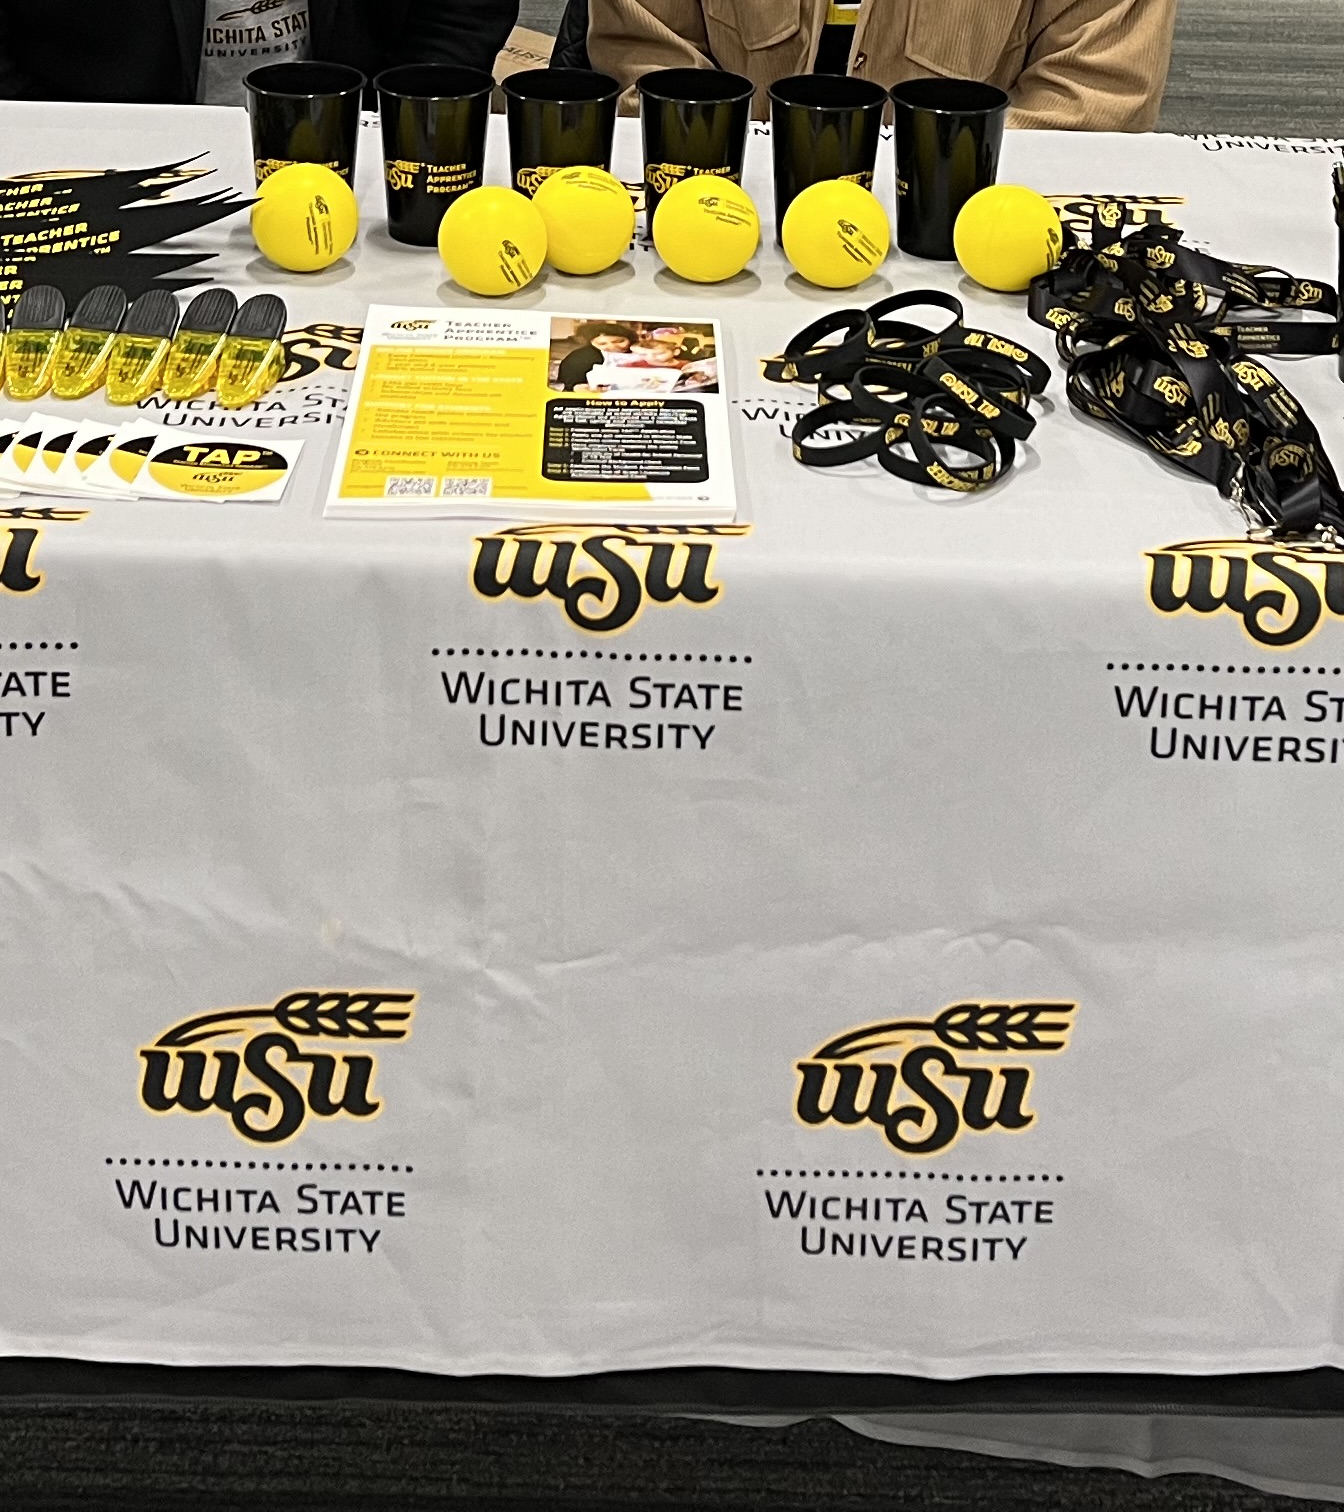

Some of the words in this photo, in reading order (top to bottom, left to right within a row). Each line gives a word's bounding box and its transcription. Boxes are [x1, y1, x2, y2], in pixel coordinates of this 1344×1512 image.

[0, 222, 88, 246] TEACHER
[441, 670, 613, 708] WICHITA
[628, 675, 744, 712] STATE
[1114, 684, 1287, 722] WICHITA
[478, 714, 716, 751] UNIVERSITY
[115, 1179, 281, 1216] WICHITA
[297, 1183, 406, 1217] STATE
[764, 1189, 929, 1223] WICHITA
[945, 1194, 1055, 1225] STATE
[154, 1218, 382, 1254] UNIVERSITY
[800, 1226, 1028, 1262] UNIVERSITY
